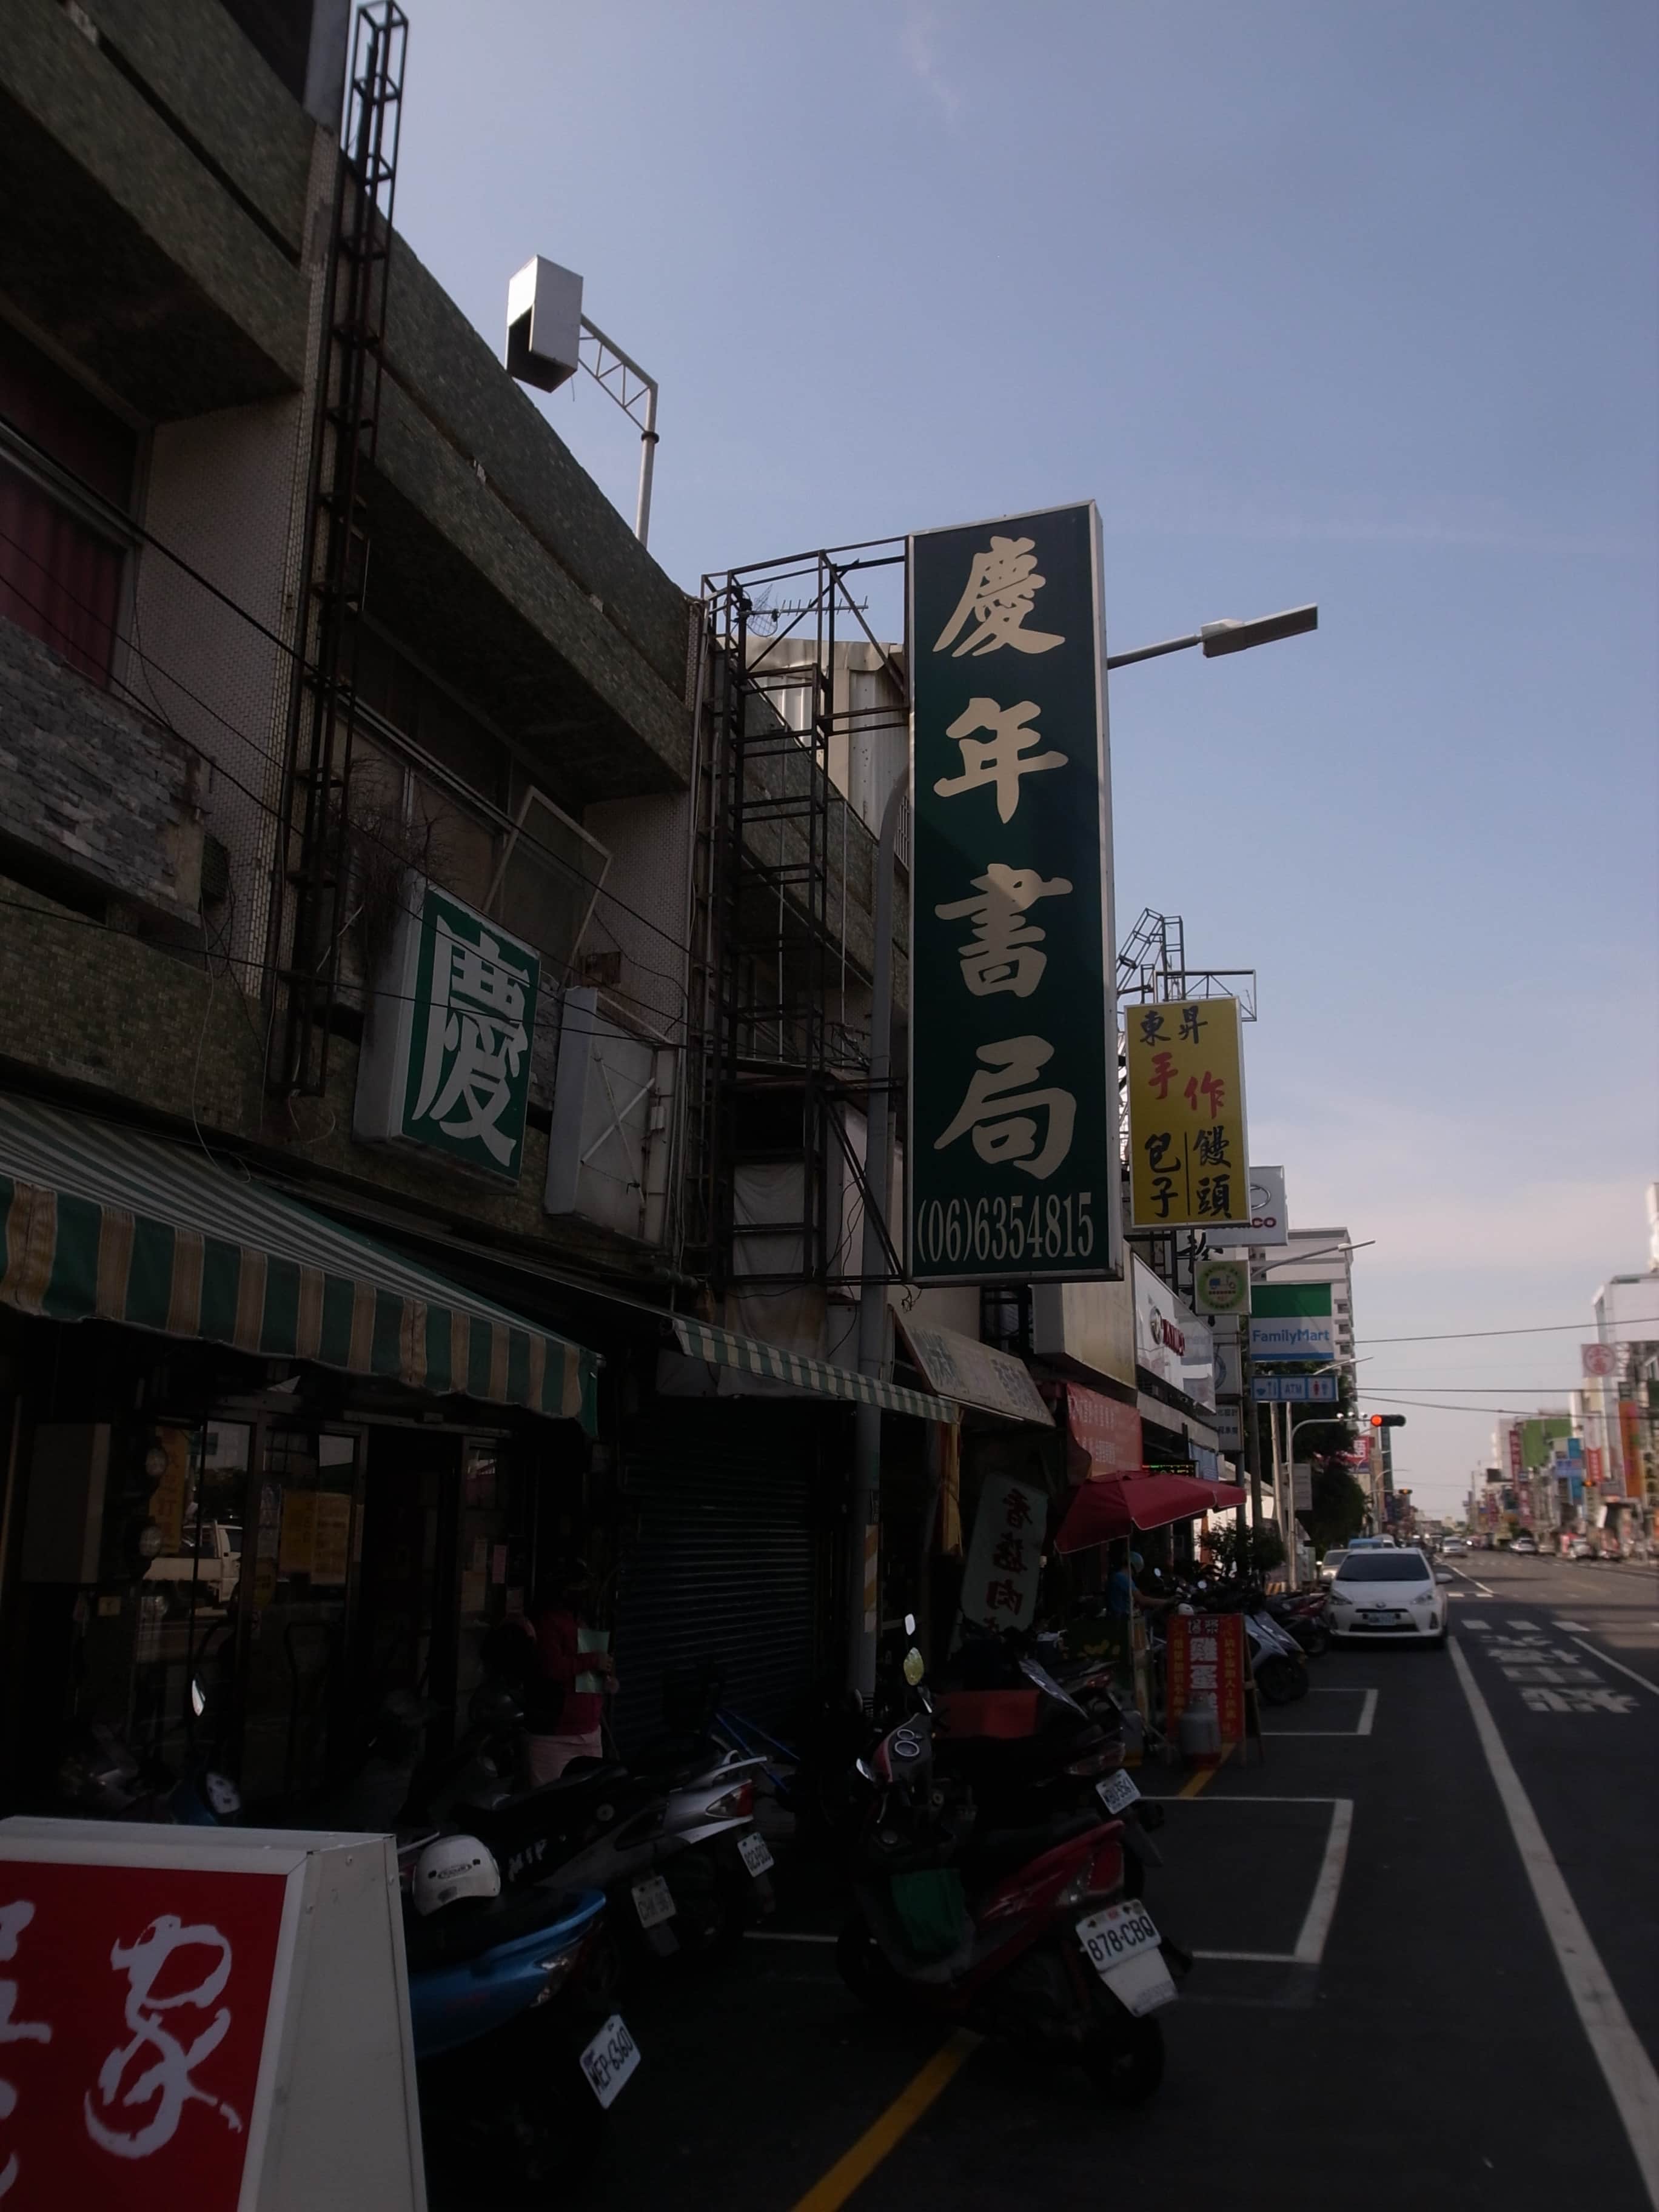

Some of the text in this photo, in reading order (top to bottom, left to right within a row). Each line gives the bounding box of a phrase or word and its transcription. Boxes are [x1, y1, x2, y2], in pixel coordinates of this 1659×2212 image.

[933, 535, 1077, 1180] 慶年書局
[411, 914, 531, 1167] 慶
[1140, 1005, 1208, 1046] 東昇
[1148, 1052, 1224, 1120] 手作
[1145, 1133, 1181, 1218] 包子
[1193, 1125, 1232, 1219] 饅頭
[917, 1191, 1094, 1263] (06)6354815
[1253, 1329, 1329, 1346] FamilyMart
[1285, 1383, 1302, 1394] ATM
